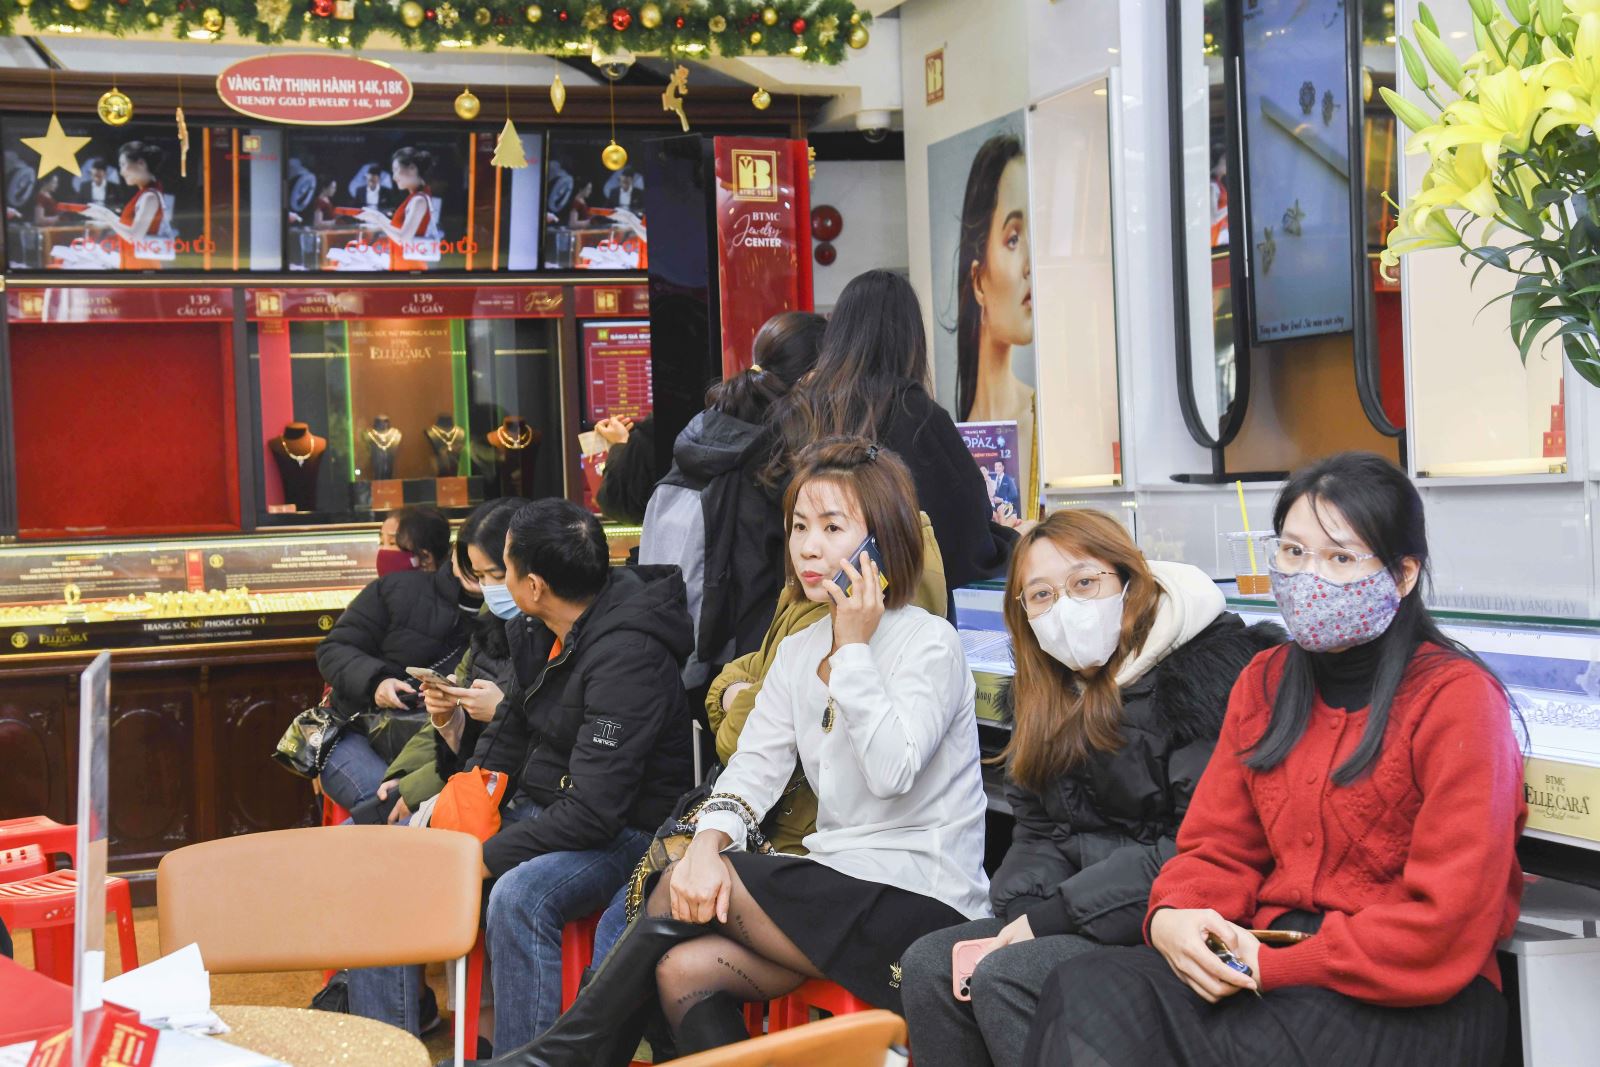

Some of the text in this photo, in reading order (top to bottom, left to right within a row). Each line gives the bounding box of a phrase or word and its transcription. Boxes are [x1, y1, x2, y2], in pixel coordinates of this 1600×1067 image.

[227, 74, 261, 92] VÀNG
[262, 75, 283, 92] TÂY
[284, 78, 321, 96] THỊNH
[322, 77, 356, 93] HÀNH
[236, 96, 277, 106] TRENDY
[278, 96, 306, 106] GOLD
[308, 97, 350, 107] JEWELRY
[752, 212, 781, 221] BTMC
[744, 238, 782, 247] CENTER
[189, 295, 211, 304] 139
[413, 294, 433, 303] 139
[961, 435, 997, 449] OPAZ
[1000, 449, 1011, 459] 12
[143, 622, 172, 631] TRANG
[204, 618, 234, 628] PHONG
[235, 616, 259, 626] CÁCH
[1545, 774, 1566, 786] BTMC
